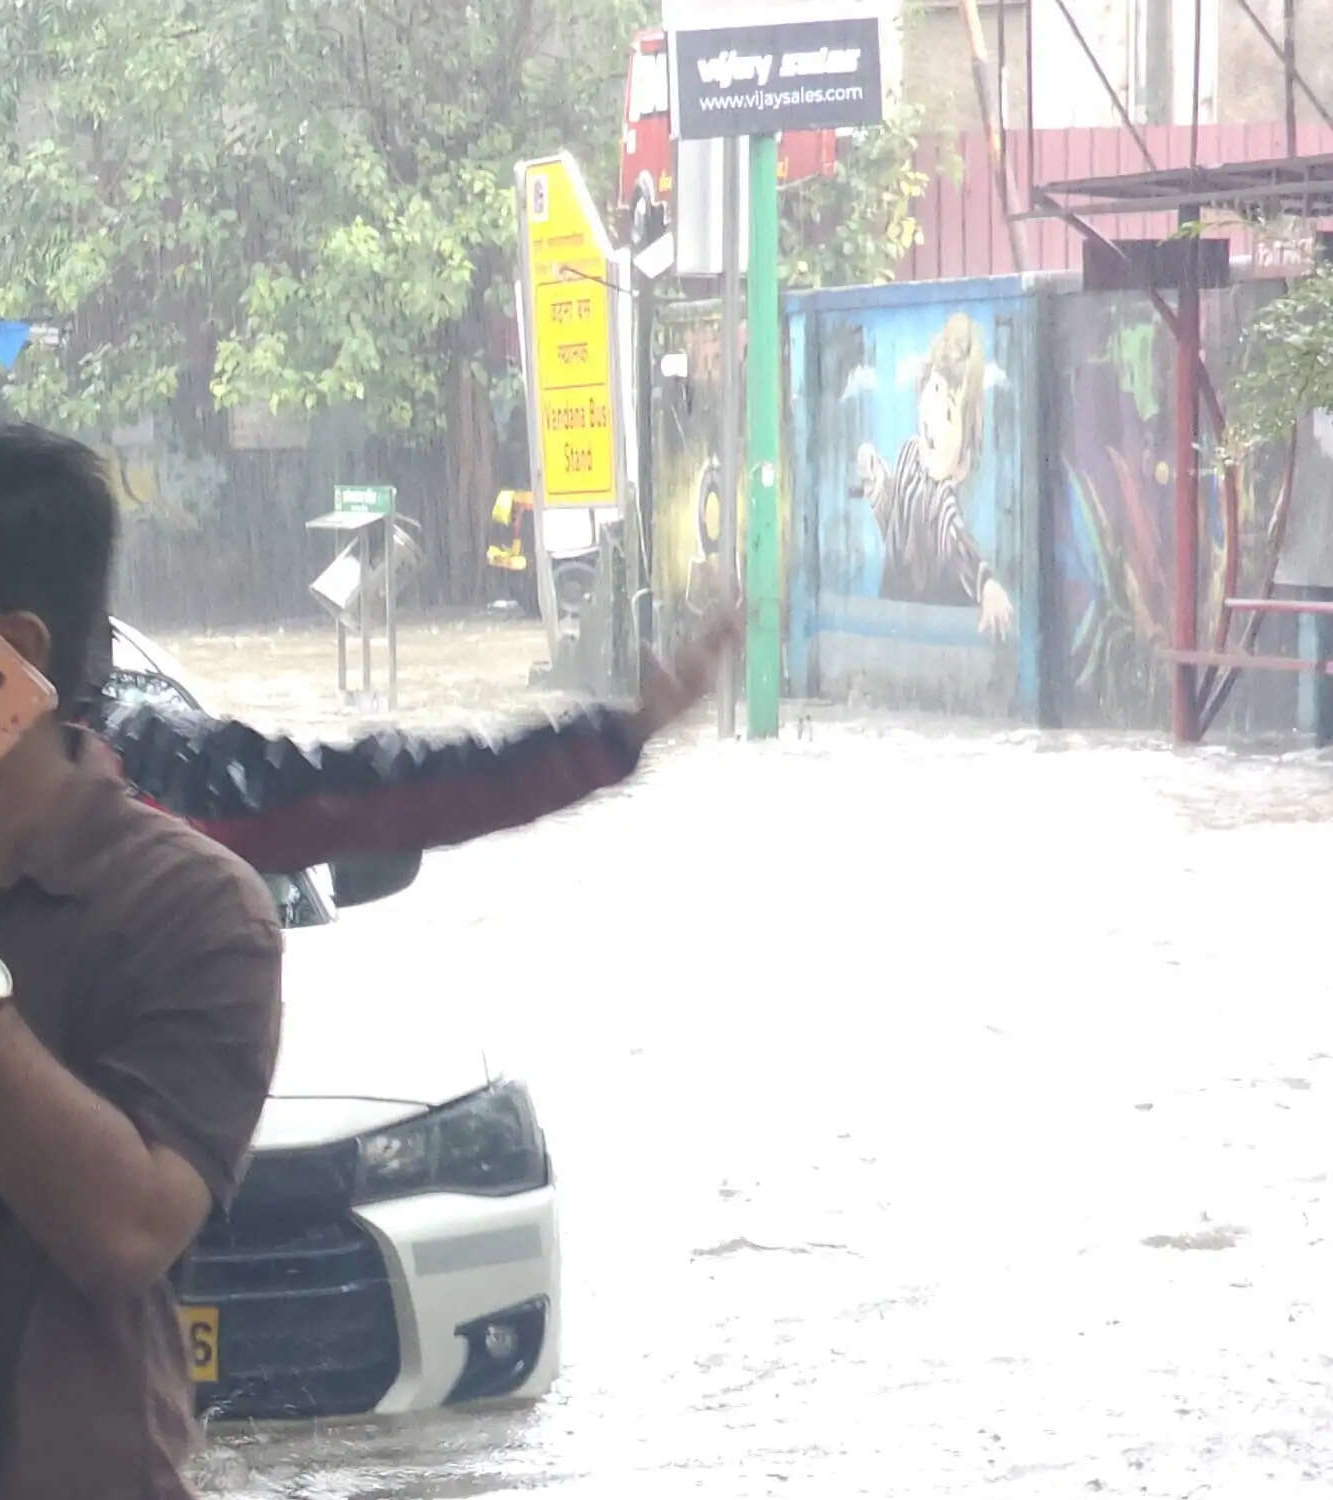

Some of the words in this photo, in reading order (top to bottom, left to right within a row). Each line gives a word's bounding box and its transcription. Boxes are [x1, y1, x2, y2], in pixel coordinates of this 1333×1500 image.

[699, 85, 864, 112] www.vijaysales.com
[544, 401, 585, 431] Vandana
[589, 396, 608, 428] Bus
[564, 440, 594, 473] Stand
